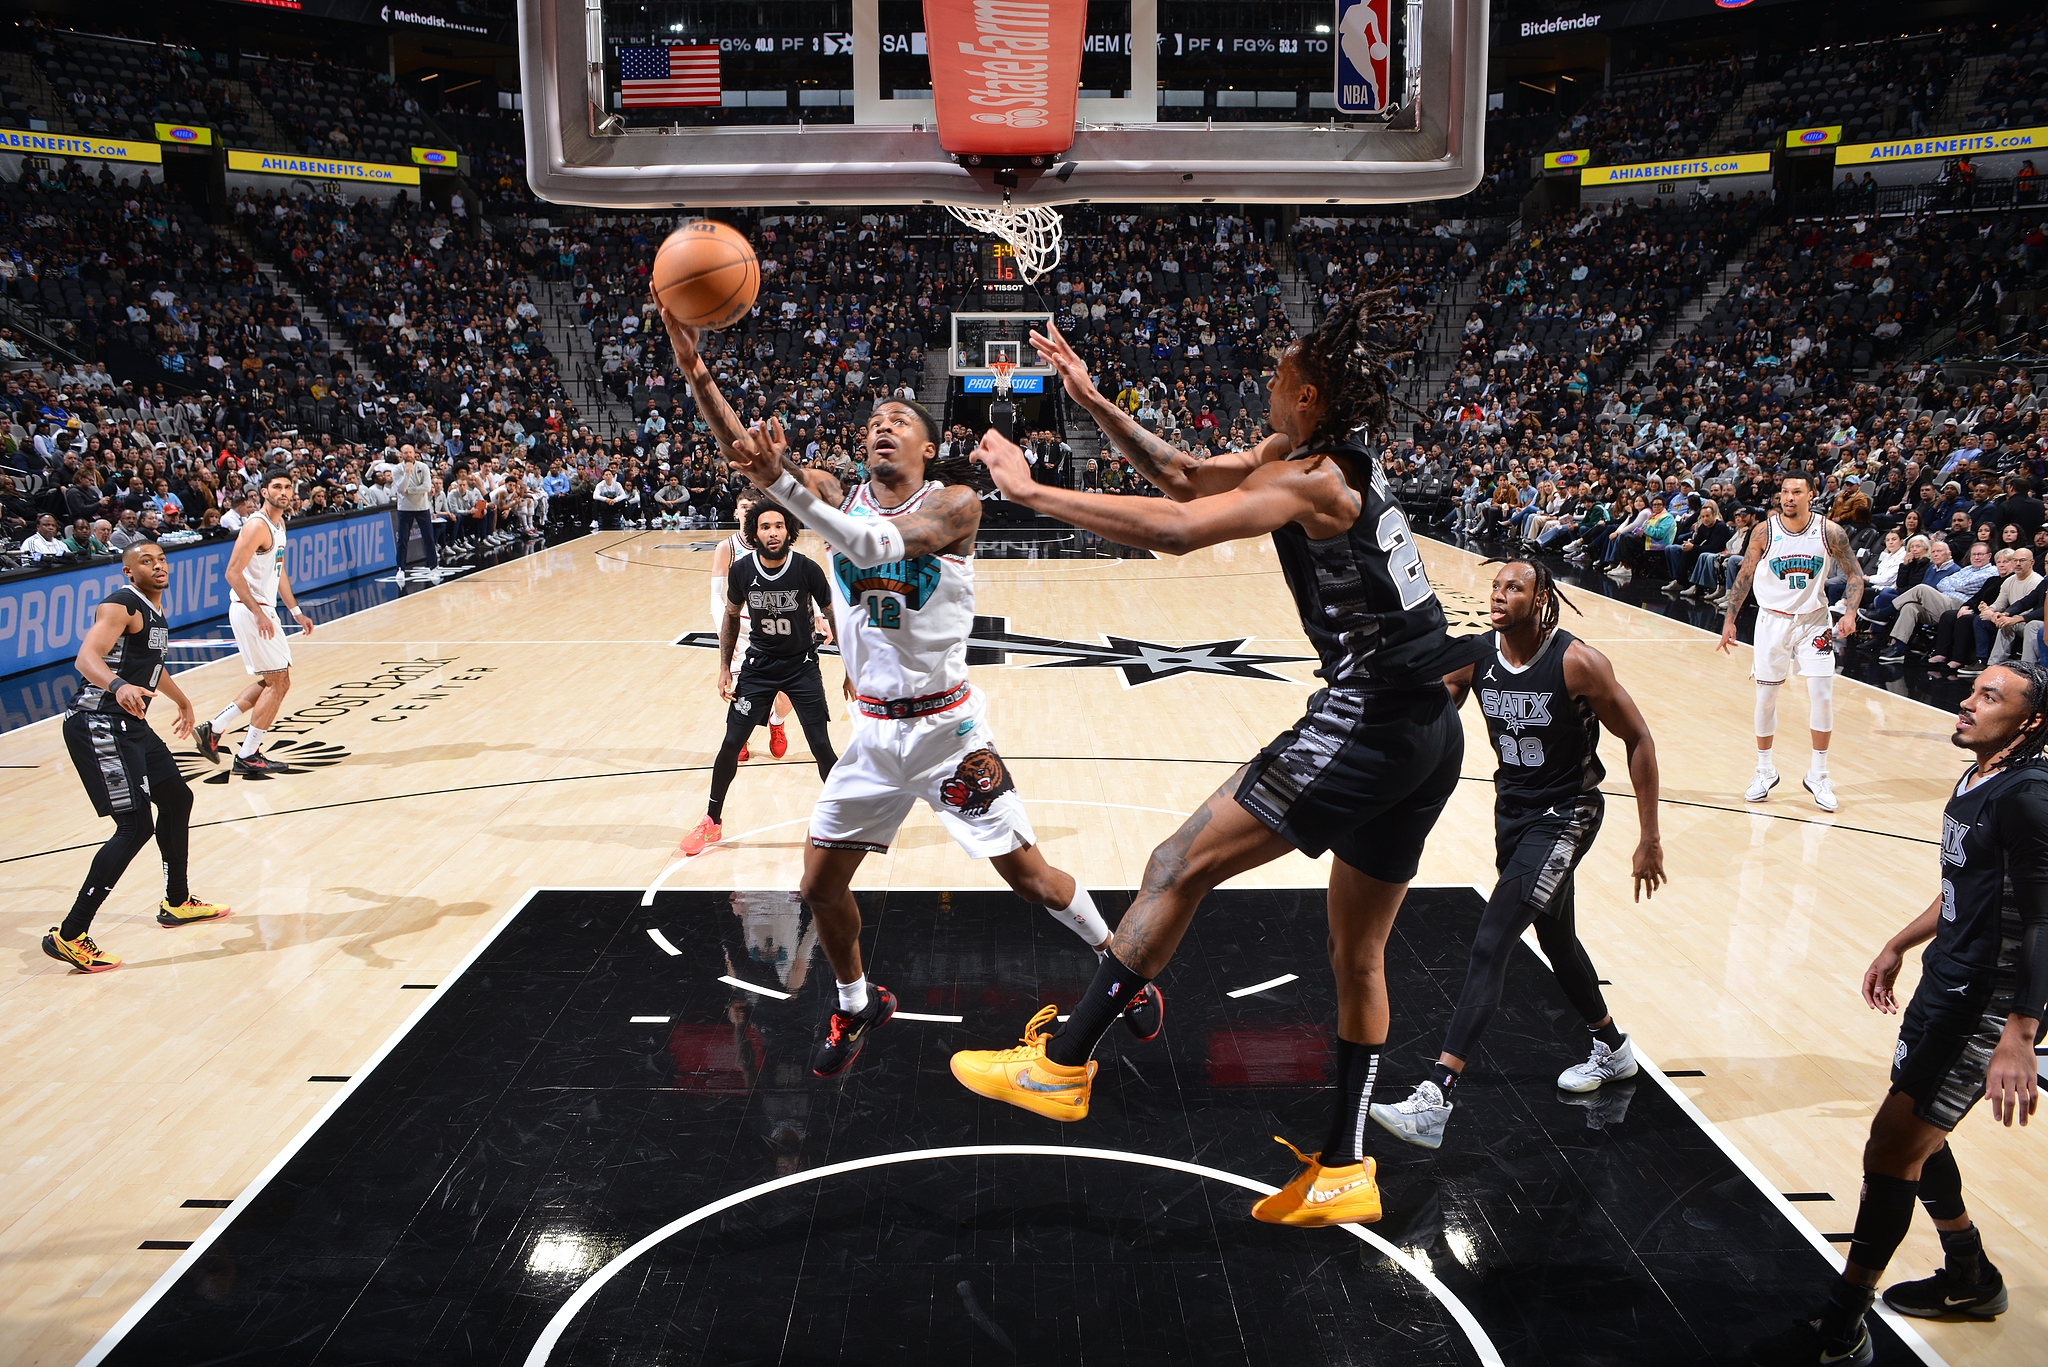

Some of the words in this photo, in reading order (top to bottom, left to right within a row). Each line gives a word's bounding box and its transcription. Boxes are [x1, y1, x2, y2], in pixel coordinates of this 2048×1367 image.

[394, 9, 446, 28] Methodist
[445, 21, 488, 34] HEALTHCARE
[1520, 13, 1601, 37] Bitdefender
[754, 37, 774, 52] 40.0
[781, 37, 805, 51] PF
[812, 37, 819, 51] 3
[882, 34, 909, 53] SA
[1083, 34, 1120, 53] MEM
[1188, 38, 1211, 52] PF
[1216, 38, 1224, 53] 4
[1233, 37, 1276, 53] FG%
[1278, 38, 1298, 53] 53.3
[1304, 39, 1329, 53] TO
[1343, 84, 1369, 105] NBA
[1869, 136, 2032, 158] AHIABENEFITS.COM
[31, 159, 49, 169] 111
[261, 158, 392, 179] AHIABENEFITS.COM
[1609, 162, 1739, 180] AHIABENEFITS.COM
[323, 183, 340, 193] 112
[1658, 183, 1675, 193] 117
[997, 257, 1014, 280] 1.6
[967, 378, 1038, 389] PROSSIVE
[284, 520, 384, 586] OGRESSIVE
[1769, 555, 1824, 580] GRIZZLIES
[1788, 575, 1807, 589] 15
[748, 590, 799, 612] SATX
[867, 595, 900, 630] 12
[761, 618, 791, 636] 30
[330, 656, 460, 690] Bank
[370, 666, 498, 724] CENTER
[1481, 688, 1553, 727] SATX
[1498, 734, 1546, 767] 28
